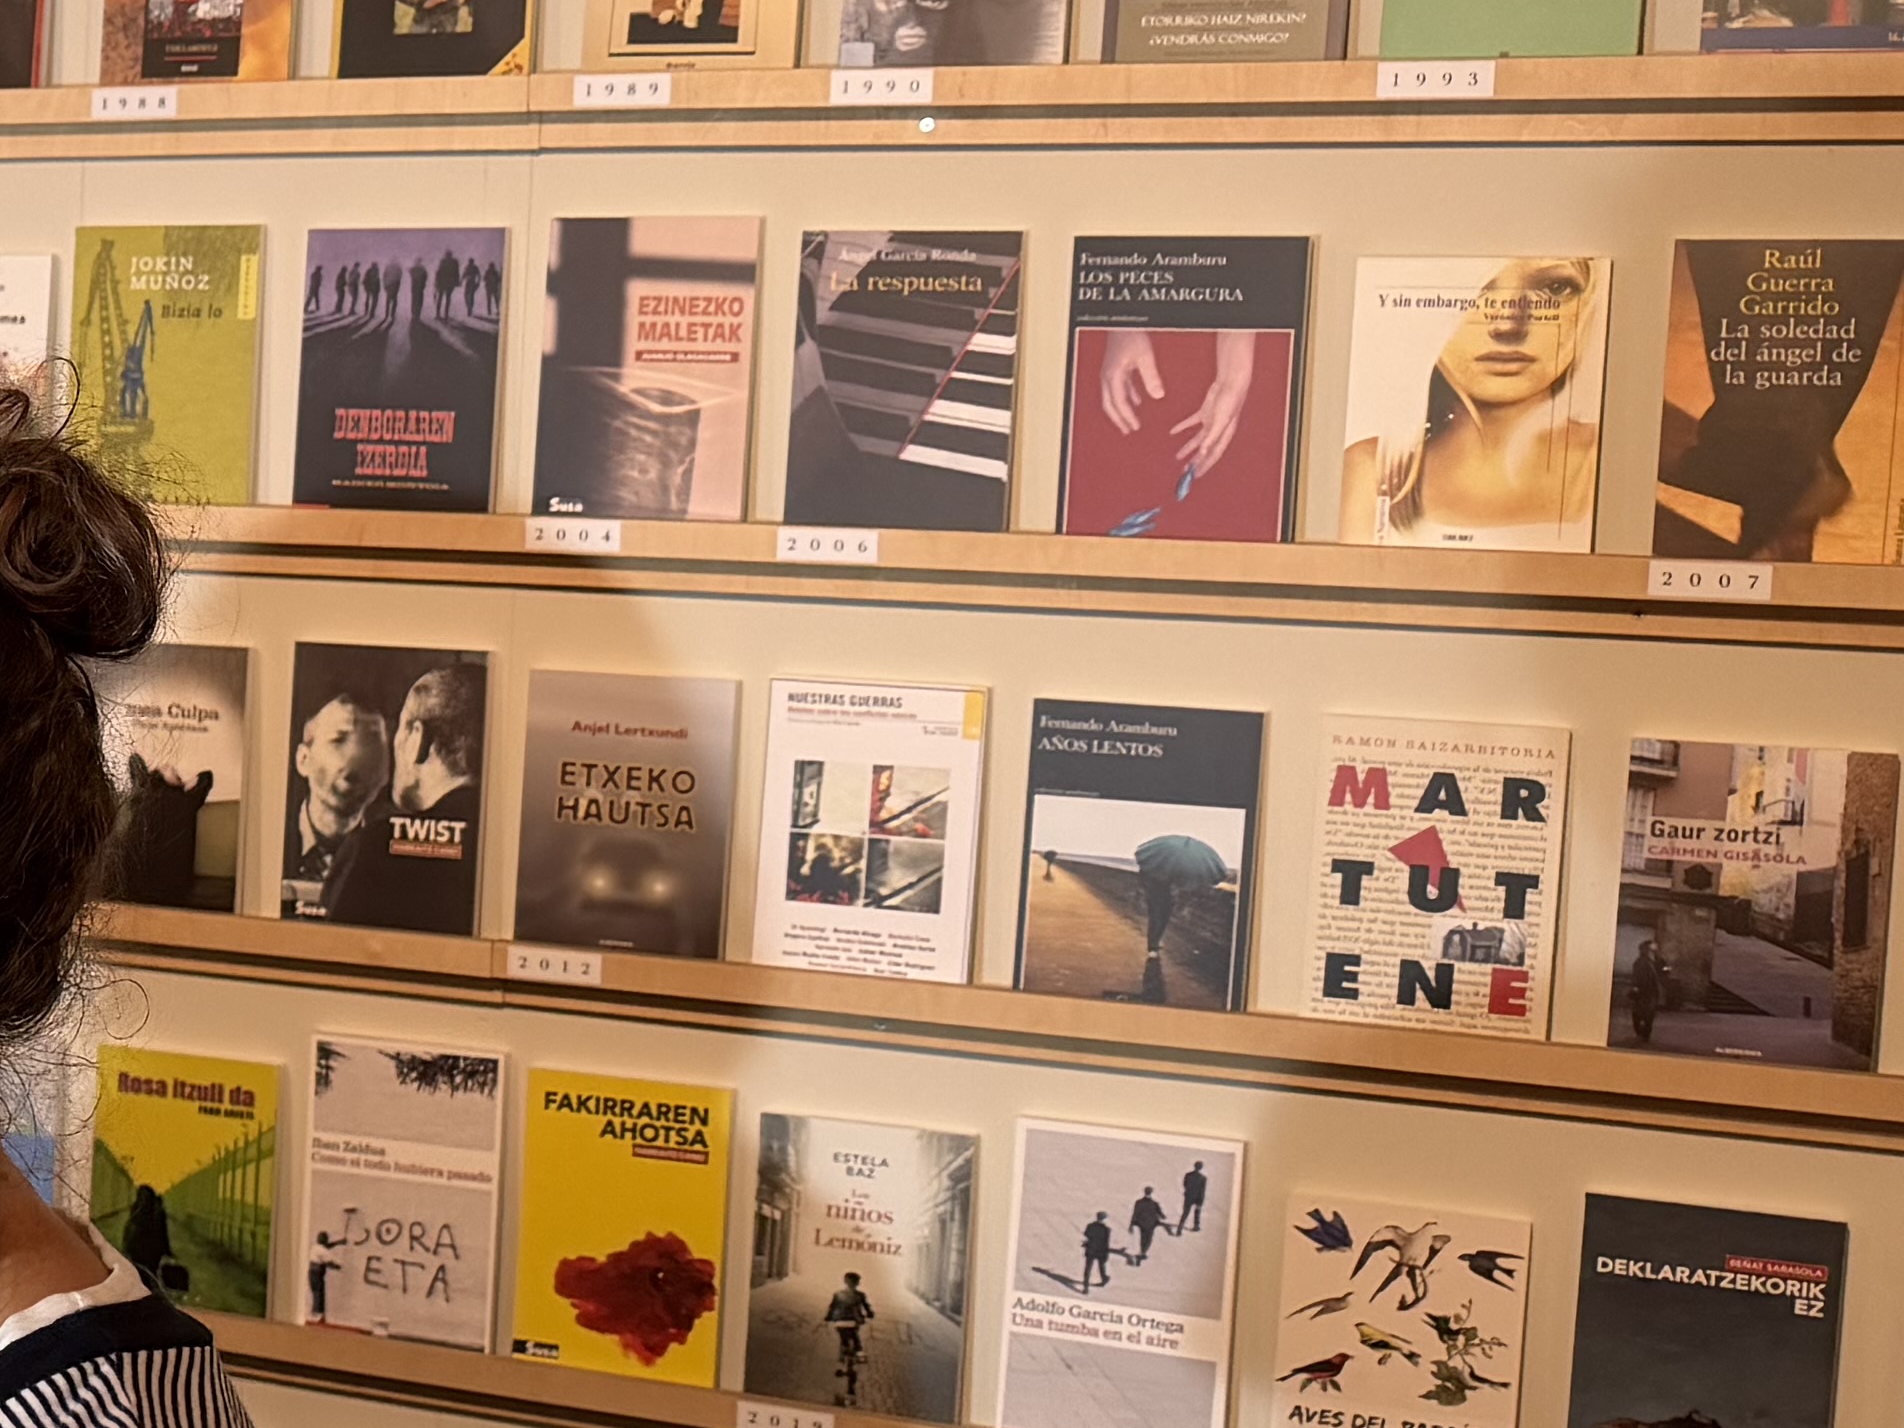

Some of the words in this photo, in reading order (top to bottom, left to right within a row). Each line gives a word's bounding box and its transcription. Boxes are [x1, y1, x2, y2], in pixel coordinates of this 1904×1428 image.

[585, 82, 659, 97] 1989
[842, 78, 921, 94] 1990
[1391, 71, 1479, 89] 1993
[102, 96, 167, 110] 1988
[130, 255, 194, 271] JOKIN
[1079, 252, 1148, 267] Fernando
[1150, 252, 1227, 267] Aramburu
[1764, 249, 1822, 270] Raúl
[129, 271, 210, 291] MUÑOZ
[829, 272, 859, 292] La
[867, 272, 983, 297] respuesta
[1078, 271, 1113, 285] LOS
[1119, 271, 1174, 285] PECES
[1746, 273, 1835, 294] Guerra
[1077, 287, 1103, 301] DE
[1109, 287, 1131, 301] LA
[1137, 288, 1243, 302] AMARGURA
[1379, 293, 1390, 308] Y
[1392, 294, 1411, 309] sin
[1415, 294, 1480, 313] embargo,
[1484, 294, 1497, 309] te
[638, 296, 745, 319] EZINEZKO
[1739, 296, 1840, 317] Garrido
[636, 321, 743, 345] MALETAK
[1719, 319, 1750, 340] La
[1760, 318, 1855, 340] soledad
[1710, 342, 1747, 363] del
[1756, 342, 1829, 366] ángel
[1832, 343, 1861, 363] de
[1724, 365, 1747, 386] la
[1755, 366, 1842, 390] guarda
[333, 408, 456, 445] DENBORAREN
[355, 443, 428, 477] IZERDIA
[534, 527, 611, 543] 2004
[787, 537, 868, 554] 2006
[1660, 572, 1761, 590] 2007
[787, 692, 846, 708] NUESTRAS
[167, 703, 219, 722] Culpa
[571, 720, 610, 737] Anjel
[614, 722, 689, 739] Lertxundi
[1038, 735, 1088, 755] AÑOS
[1092, 740, 1164, 758] LENTOS
[560, 761, 696, 795] ETXEKO
[1328, 764, 1546, 823] MAR
[556, 796, 696, 830] HAUTSA
[390, 816, 467, 844] TWIST
[1651, 819, 1702, 841] Gaur
[1713, 826, 1782, 845] zortzi
[1647, 845, 1718, 860] CARMEN
[1330, 859, 1540, 920] TUT
[518, 956, 590, 975] 2012
[1322, 952, 1529, 1016] ENE
[118, 1072, 167, 1099] Rosa
[229, 1083, 255, 1108] da
[544, 1091, 710, 1126] FAKIRRAREN
[599, 1119, 709, 1149] AHOTSA
[832, 1151, 889, 1168] ESTELA
[845, 1166, 876, 1178] BAZ
[825, 1198, 895, 1225] niños
[813, 1228, 903, 1257] Lemóniz
[363, 1255, 451, 1302] ETA
[1596, 1255, 1827, 1300] DEKLARATZEKORIK
[1012, 1297, 1065, 1318] Adolfo
[1069, 1305, 1123, 1326] García
[1127, 1313, 1184, 1336] Ortega
[1794, 1299, 1824, 1318] EZ
[1011, 1312, 1043, 1329] Una
[1047, 1317, 1099, 1339] tumba
[1102, 1325, 1123, 1341] en
[1126, 1328, 1142, 1344] el
[1145, 1333, 1179, 1350] aire
[1288, 1405, 1344, 1428] AVES
